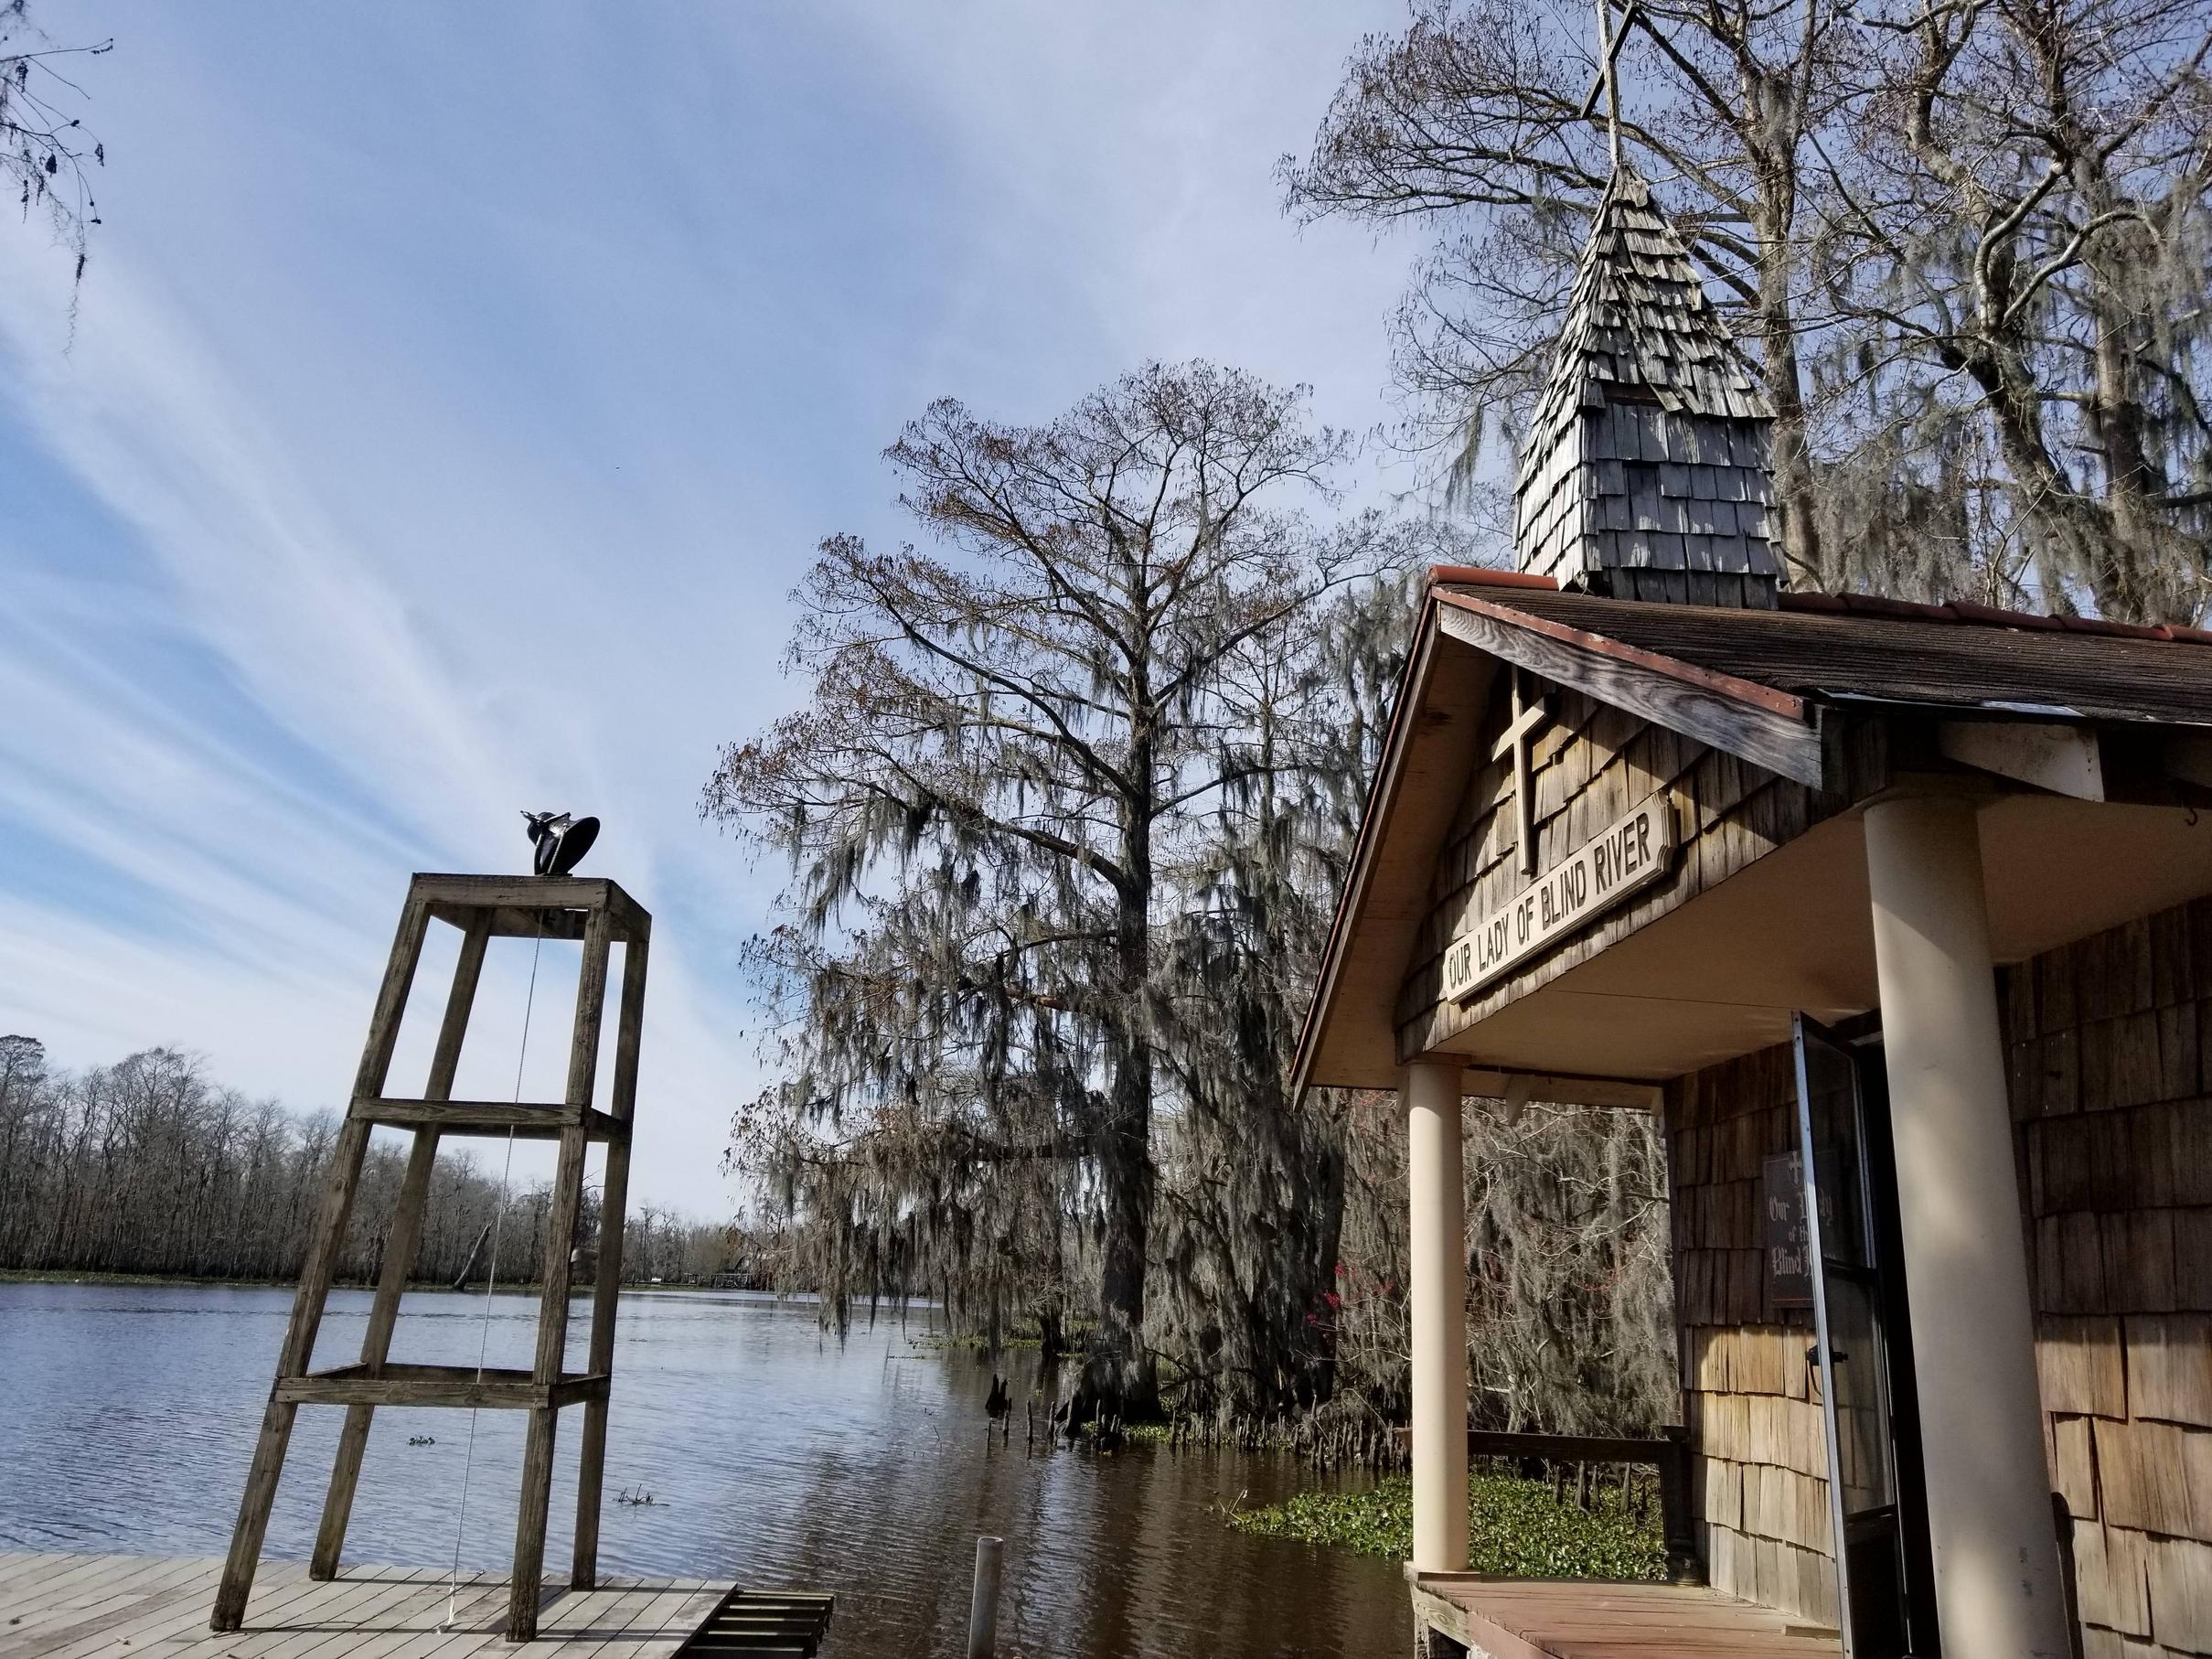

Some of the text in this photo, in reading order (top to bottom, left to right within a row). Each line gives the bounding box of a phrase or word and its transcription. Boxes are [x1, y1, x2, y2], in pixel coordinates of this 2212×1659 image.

[1448, 811, 1651, 990] OUR LADY OF BLIND RIVER
[1769, 1188, 1833, 1227] Our Ldy
[1788, 1225, 1797, 1242] of
[1772, 1245, 1802, 1277] Blind
